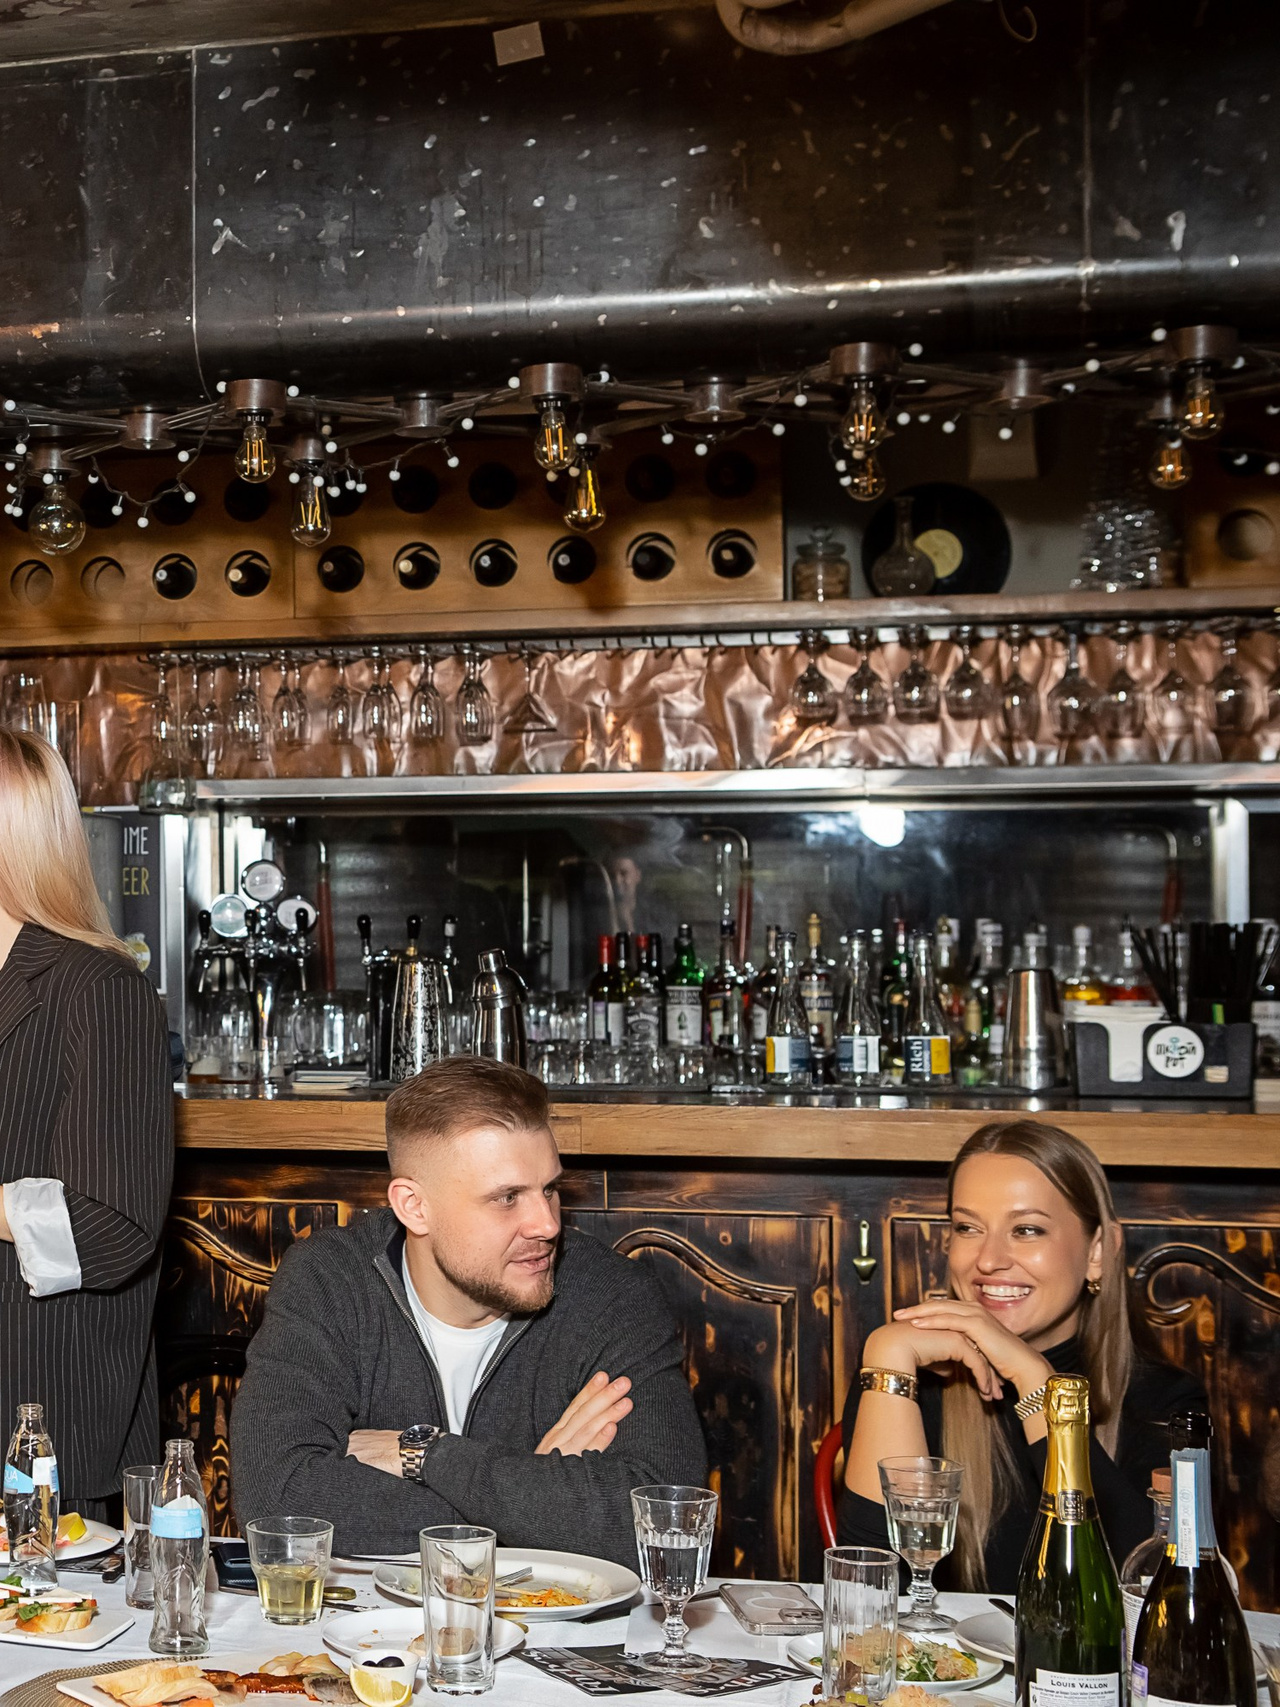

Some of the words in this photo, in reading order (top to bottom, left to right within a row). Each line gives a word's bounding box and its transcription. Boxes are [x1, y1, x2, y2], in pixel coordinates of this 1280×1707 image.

[123, 826, 149, 855] IME
[122, 867, 150, 896] EER
[910, 1040, 923, 1073] Rich
[1050, 1679, 1076, 1689] LOUIS
[1078, 1682, 1109, 1690] VALLON
